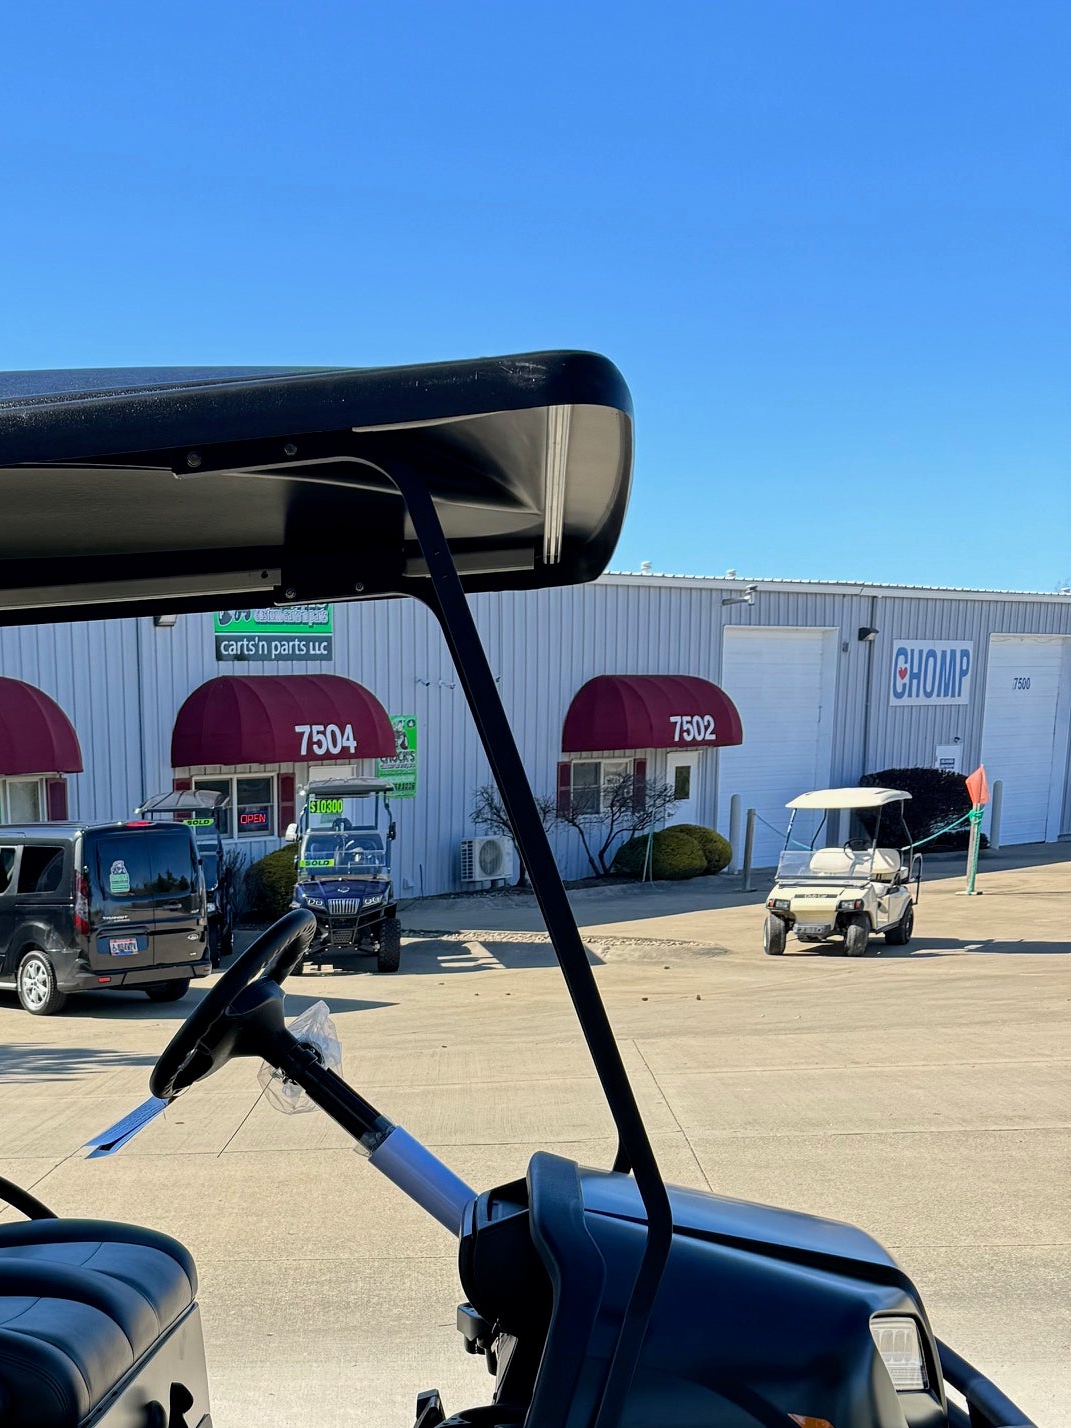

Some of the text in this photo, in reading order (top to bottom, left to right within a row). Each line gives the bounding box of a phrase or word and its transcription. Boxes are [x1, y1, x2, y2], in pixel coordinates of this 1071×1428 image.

[271, 639, 307, 659] parts
[309, 641, 329, 655] LLC
[892, 646, 971, 699] CHOMP
[1013, 677, 1031, 690] 7500
[669, 714, 717, 742] 7502
[294, 724, 357, 756] 7504
[309, 799, 344, 814] $10300
[240, 813, 266, 824] OPEN
